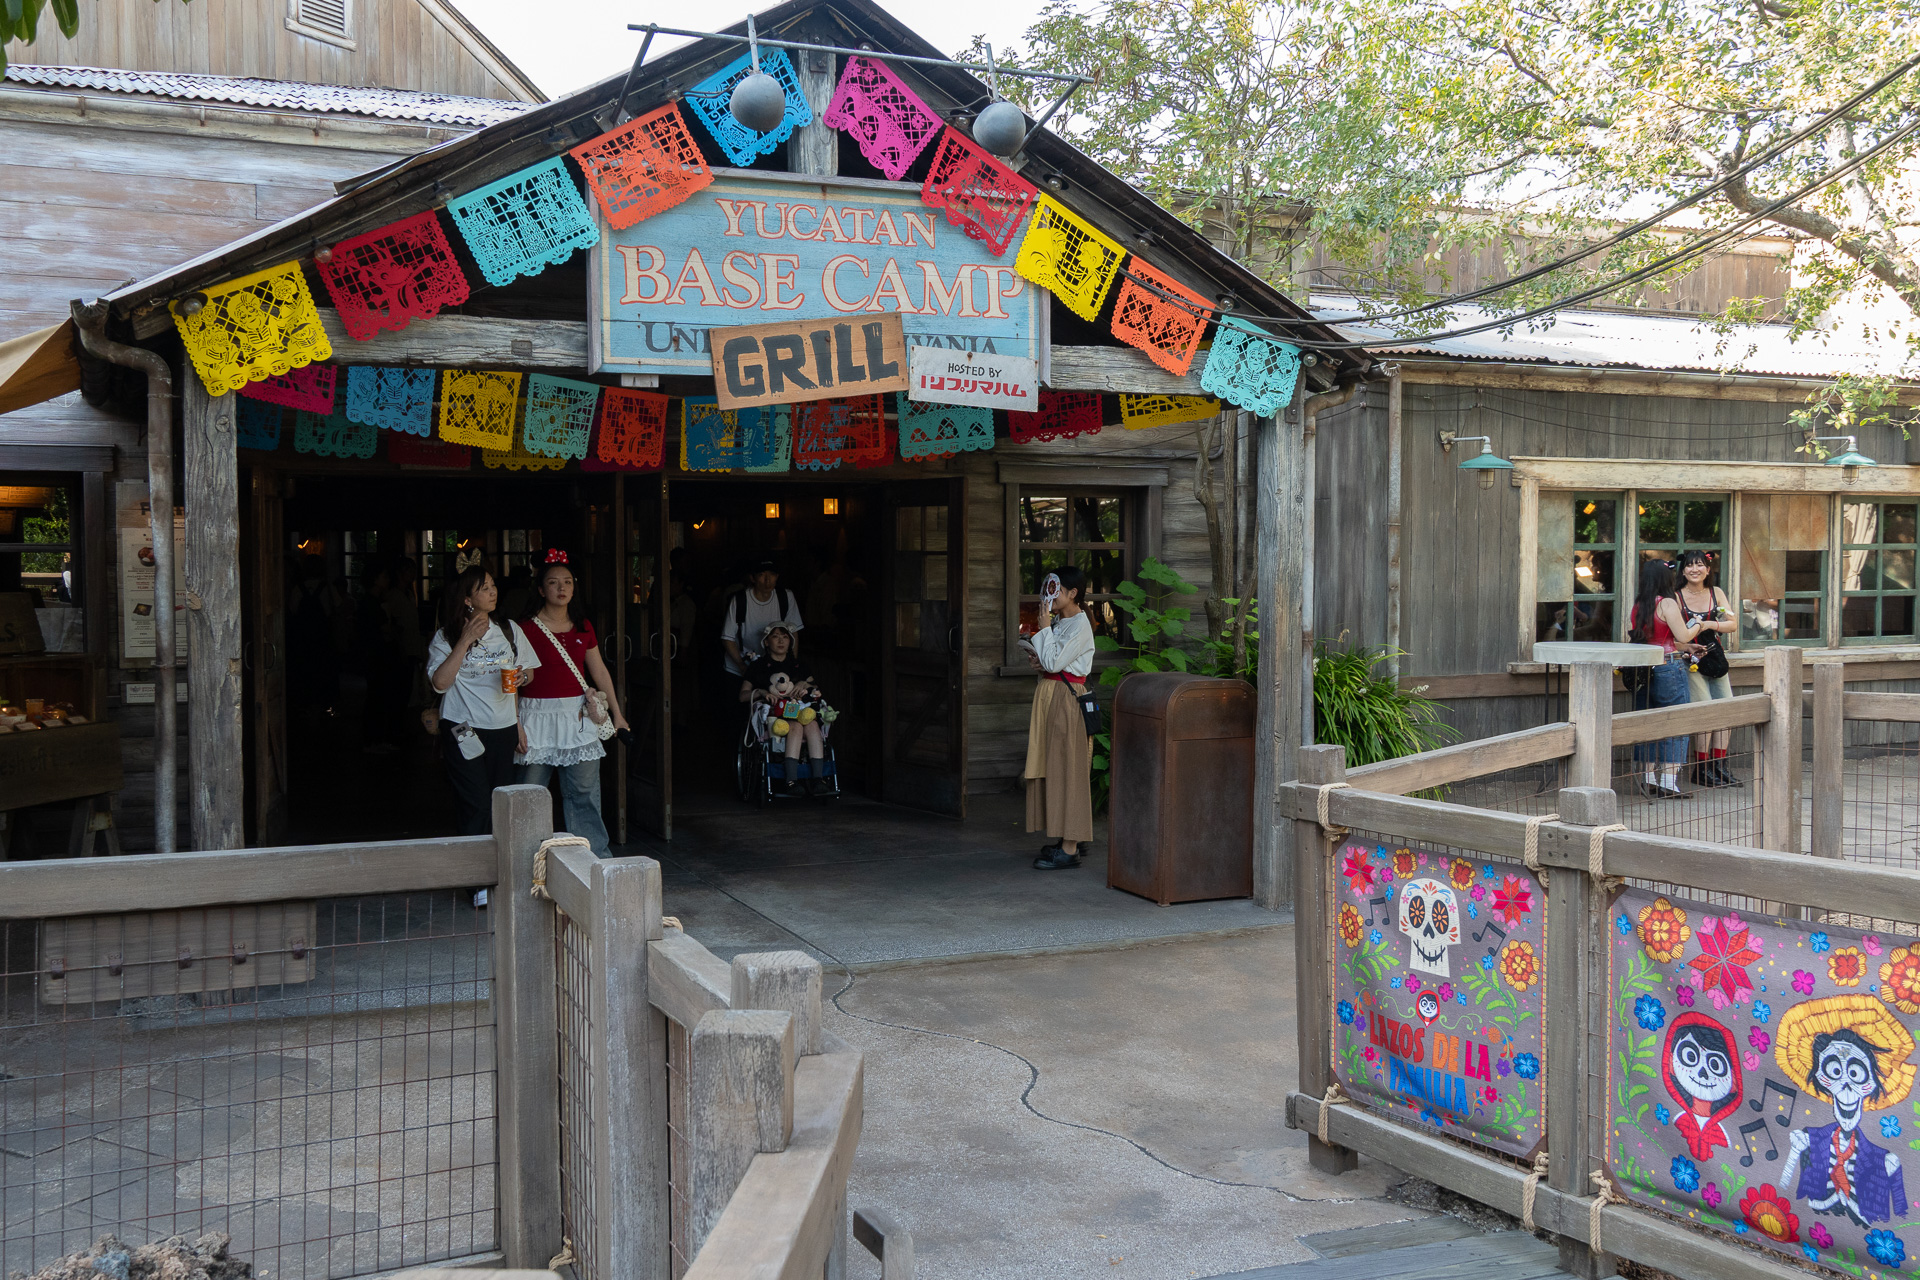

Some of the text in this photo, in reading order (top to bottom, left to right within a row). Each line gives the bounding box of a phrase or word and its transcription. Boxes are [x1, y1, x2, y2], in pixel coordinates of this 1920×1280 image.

[715, 197, 938, 249] YUCATAN
[614, 244, 1025, 319] BASE CAMP
[722, 321, 899, 399] GRILL
[947, 362, 1002, 378] HOSTED BY
[1369, 1009, 1492, 1083] LAZOS DE LA
[1388, 1055, 1470, 1116] FAMILIA
